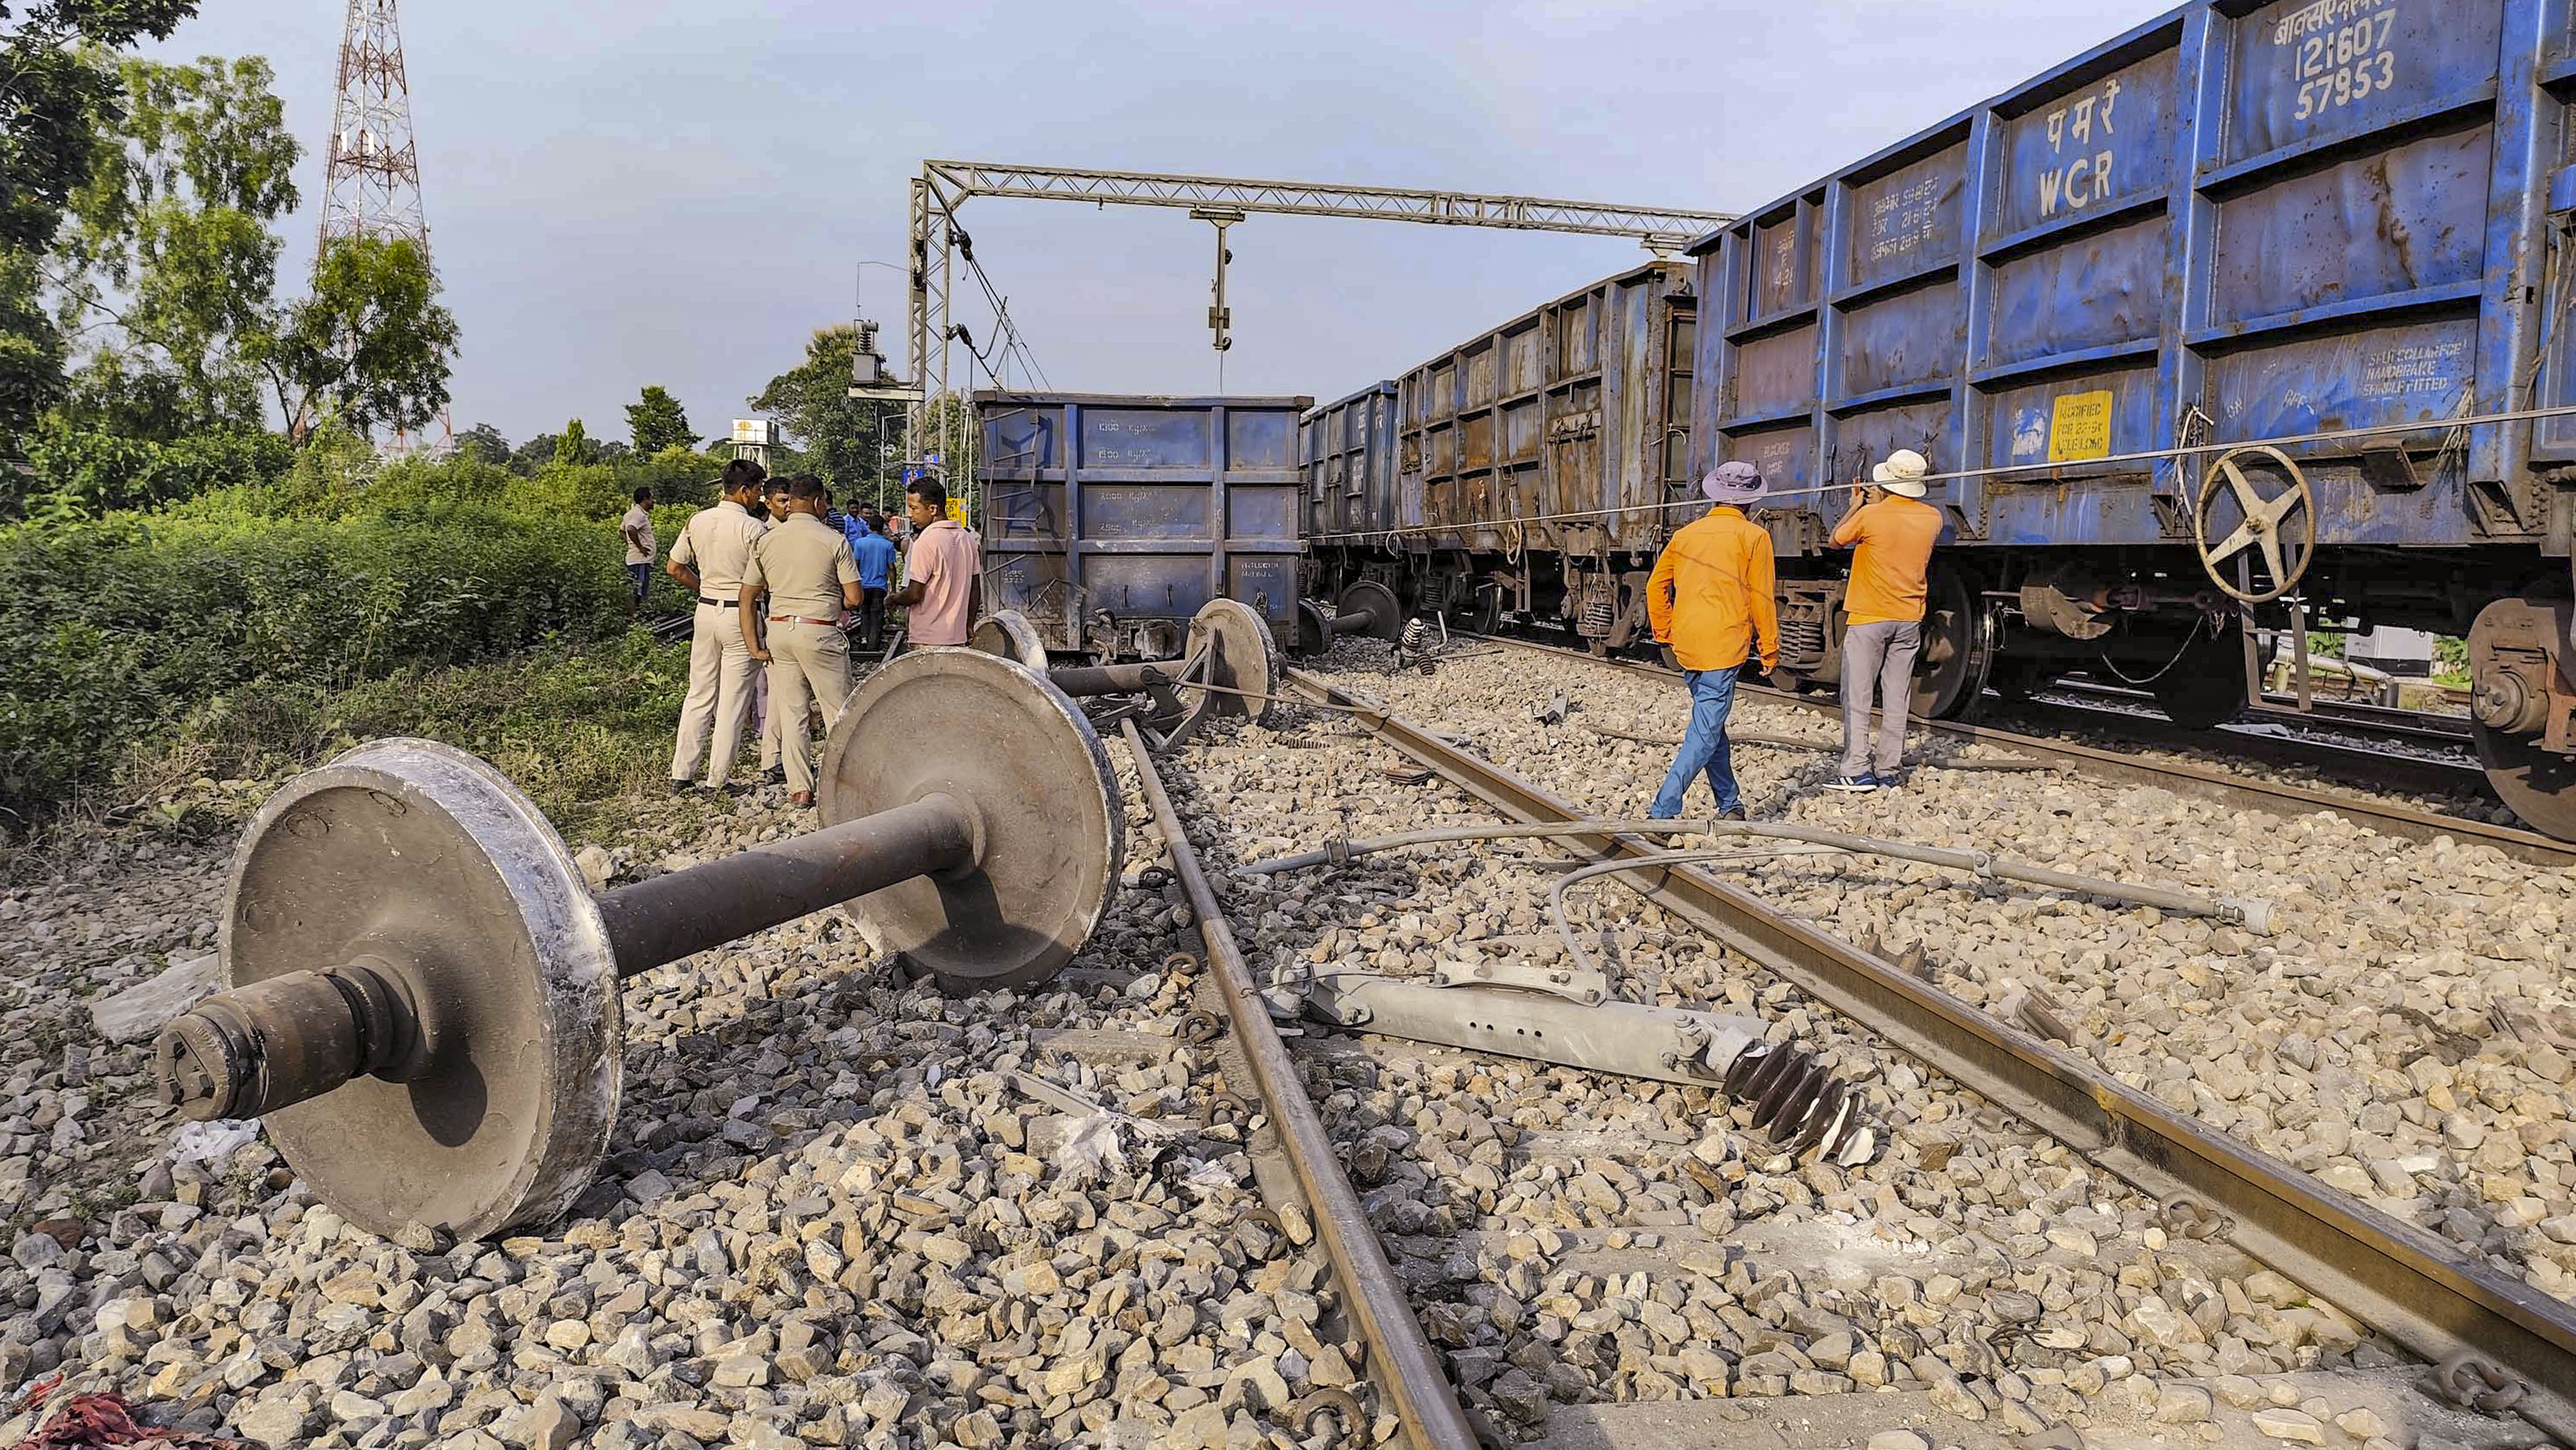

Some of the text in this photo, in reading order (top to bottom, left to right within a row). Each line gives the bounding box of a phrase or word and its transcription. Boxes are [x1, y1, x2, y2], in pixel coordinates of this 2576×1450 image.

[2294, 8, 2396, 82] 121607
[2293, 50, 2395, 120] 57953
[2039, 150, 2114, 216] WCR
[2367, 361, 2436, 381] HANDBRAKE
[2406, 377, 2448, 392] FITTED
